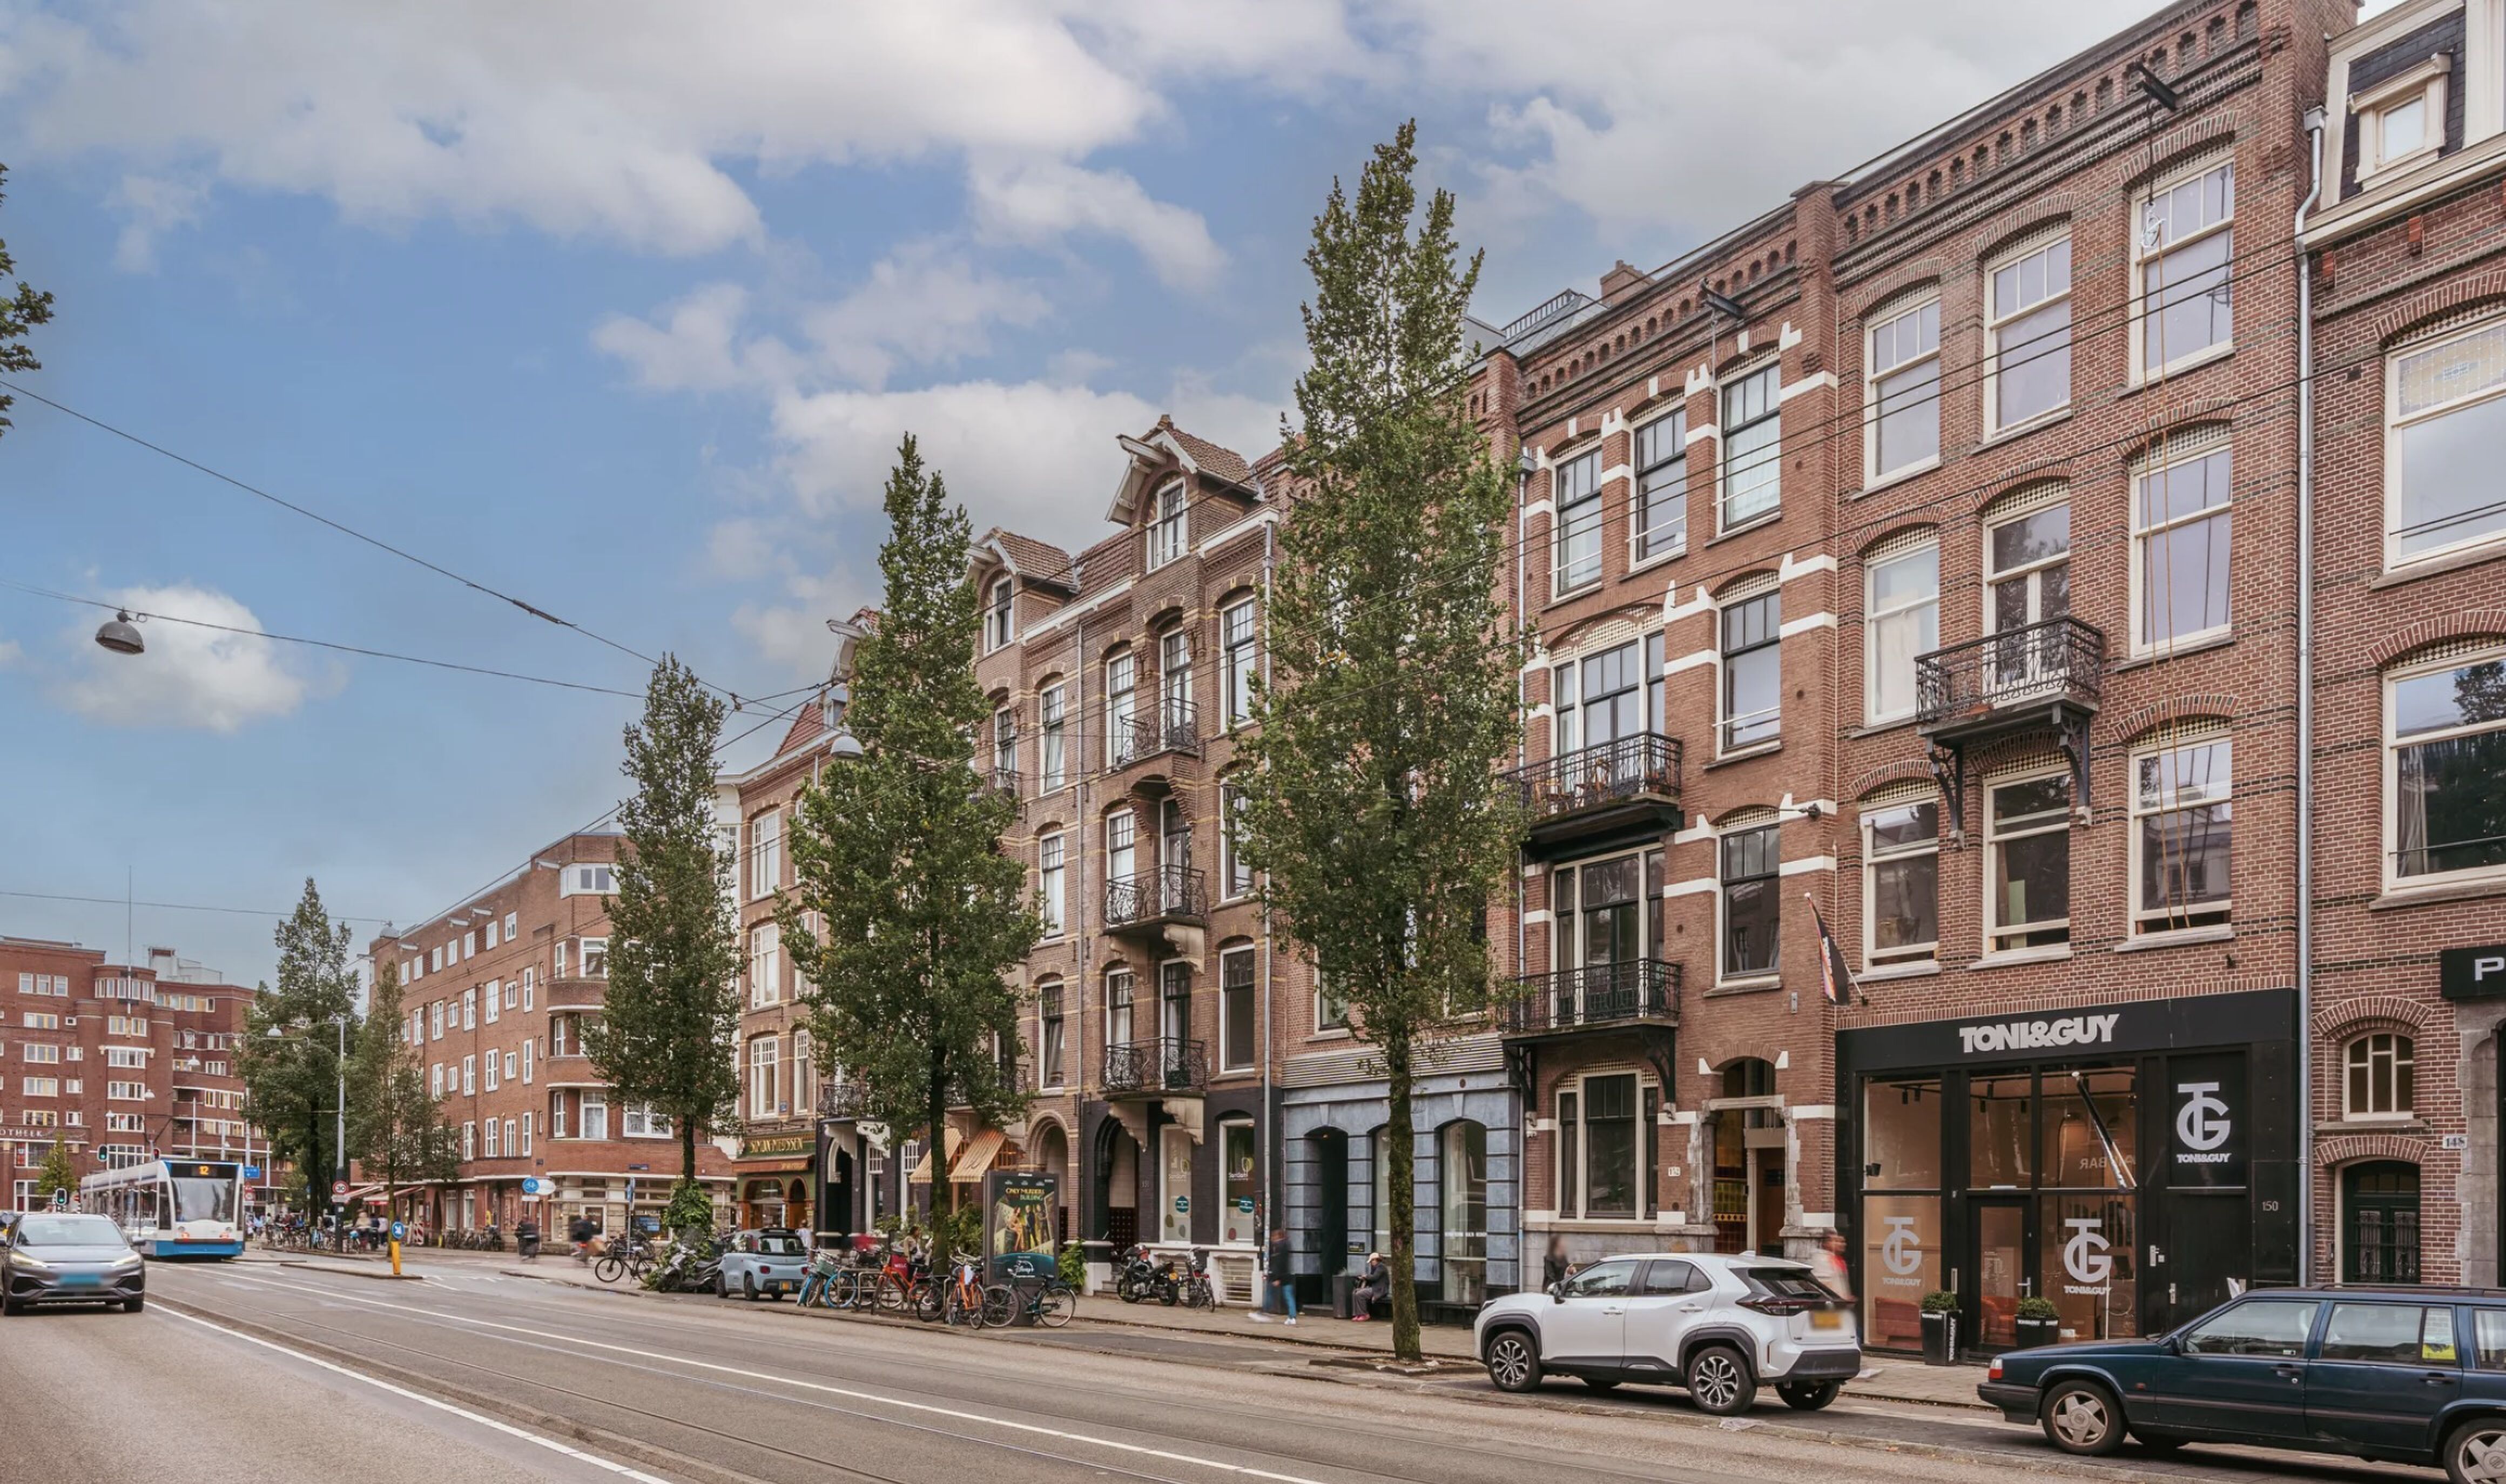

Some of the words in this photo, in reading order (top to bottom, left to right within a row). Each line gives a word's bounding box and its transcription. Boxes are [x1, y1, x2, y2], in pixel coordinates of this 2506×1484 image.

[2475, 956, 2505, 981] P
[1959, 1014, 2120, 1053] TONI&GUY
[2177, 1153, 2231, 1164] TONI&GUY
[199, 1166, 208, 1175] 12
[2262, 1201, 2279, 1211] 150
[1882, 1278, 1921, 1287] TONI&GUY
[2064, 1286, 2113, 1294] TONI&GUY
